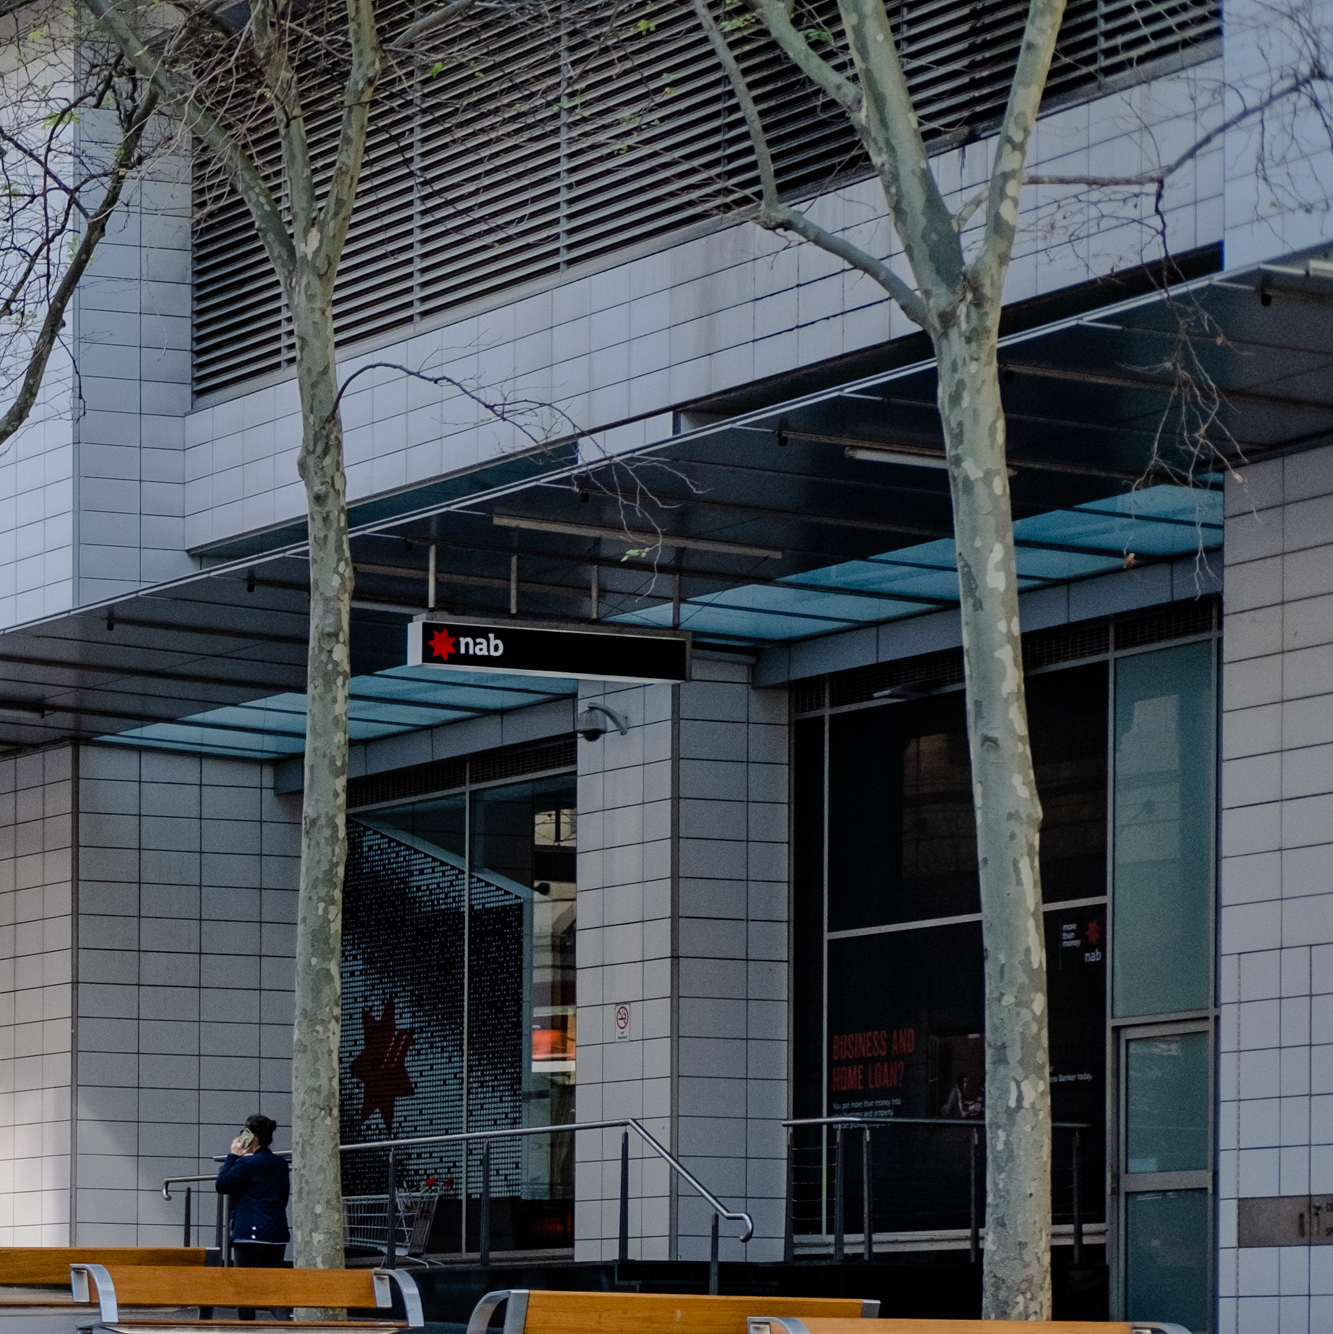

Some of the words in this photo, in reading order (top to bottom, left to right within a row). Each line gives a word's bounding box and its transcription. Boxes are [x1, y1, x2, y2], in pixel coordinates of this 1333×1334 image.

[459, 633, 504, 657] nab
[1084, 948, 1102, 962] nab
[832, 1030, 887, 1060] BUSINESS
[892, 1029, 915, 1055] AND
[832, 1065, 864, 1092] HOME
[868, 1061, 905, 1089] LOAN?
